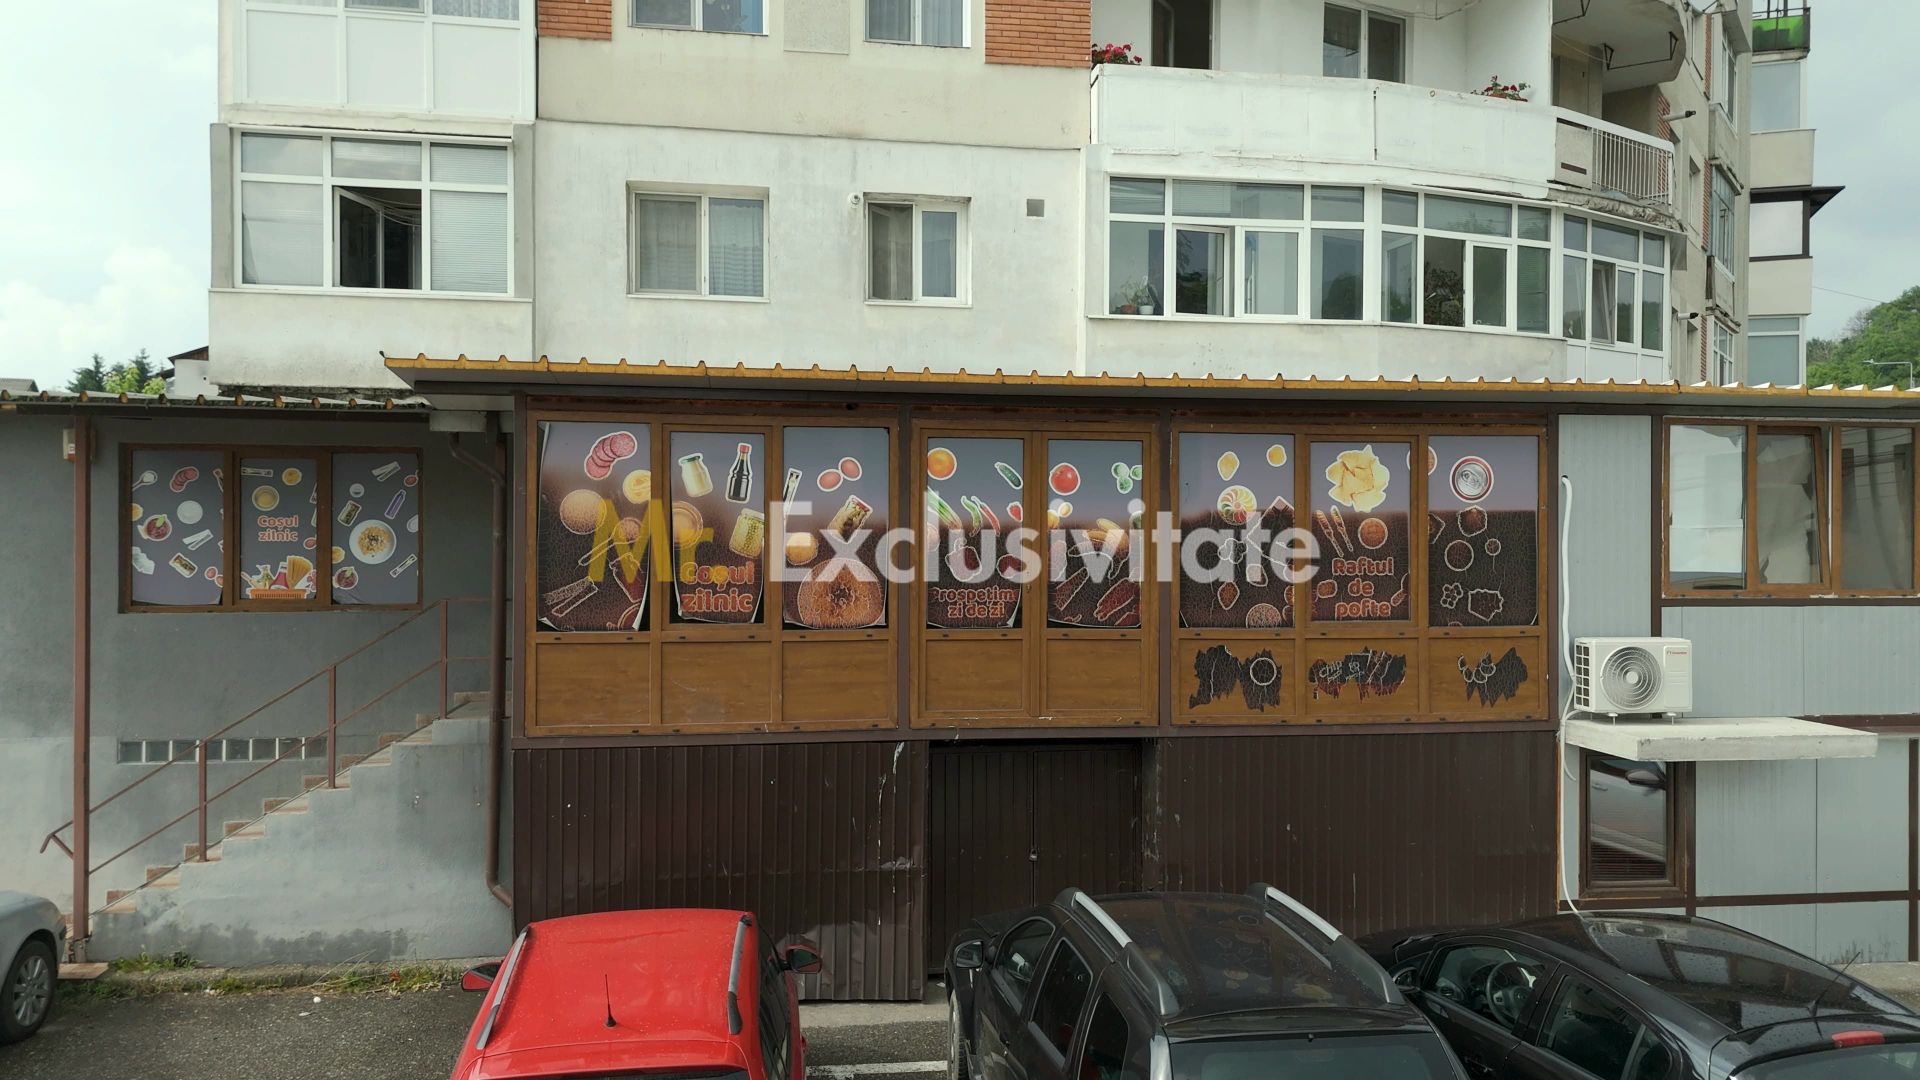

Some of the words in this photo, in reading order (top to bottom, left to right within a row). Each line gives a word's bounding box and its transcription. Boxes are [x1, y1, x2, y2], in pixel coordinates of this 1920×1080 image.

[257, 514, 299, 530] Coșul
[258, 529, 299, 542] zilnic
[1332, 556, 1394, 576] Raftul
[1347, 577, 1374, 597] de
[681, 587, 754, 613] zilnic
[948, 601, 963, 618] zi
[965, 602, 988, 618] de
[1335, 598, 1392, 620] pofte
